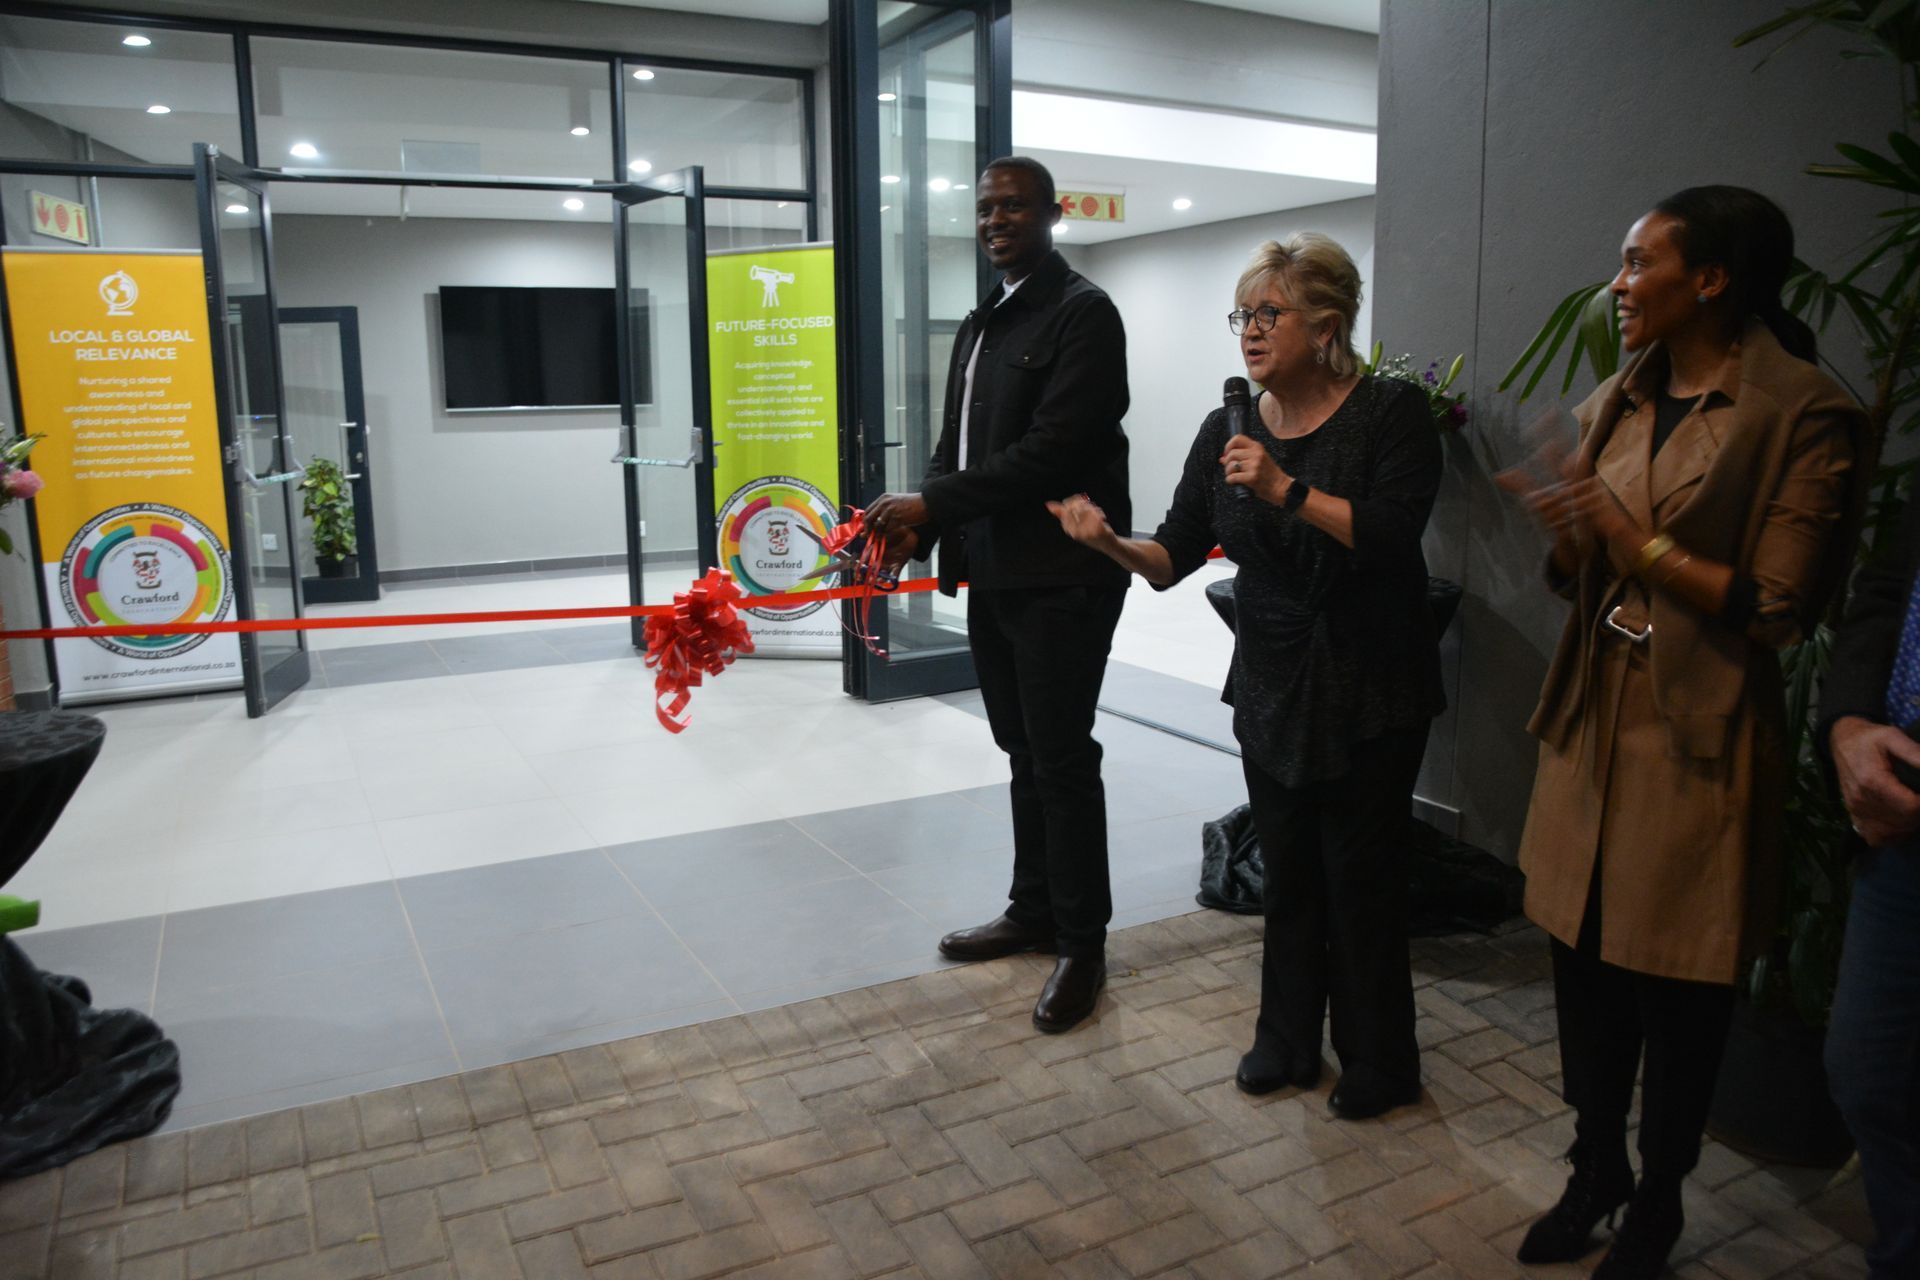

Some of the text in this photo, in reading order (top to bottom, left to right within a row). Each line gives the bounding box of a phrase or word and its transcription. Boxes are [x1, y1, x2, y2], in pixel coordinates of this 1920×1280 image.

[715, 316, 834, 333] FUTURE-FOCUSED
[49, 329, 195, 343] LOCAL & GLOBAL
[753, 333, 798, 347] SKILLS
[75, 347, 177, 361] RELEVANCE
[735, 361, 770, 370] Acquiring
[79, 377, 129, 387] Nurturing
[137, 376, 172, 384] shared
[753, 373, 796, 381] conceptual
[64, 401, 192, 413] understanding of local and
[72, 415, 186, 429] global perspectives and
[133, 430, 184, 439] encourage
[75, 441, 190, 452] interconnectedness and
[72, 457, 136, 465] international
[89, 471, 120, 479] future
[786, 477, 804, 487] World
[142, 503, 150, 511] A
[151, 504, 175, 515] World
[182, 511, 222, 549] Opportunities
[756, 559, 803, 569] Crawford
[120, 591, 180, 605] Crawford
[125, 649, 147, 658] World
[84, 662, 236, 681] www.crawfordinternational.co.za
